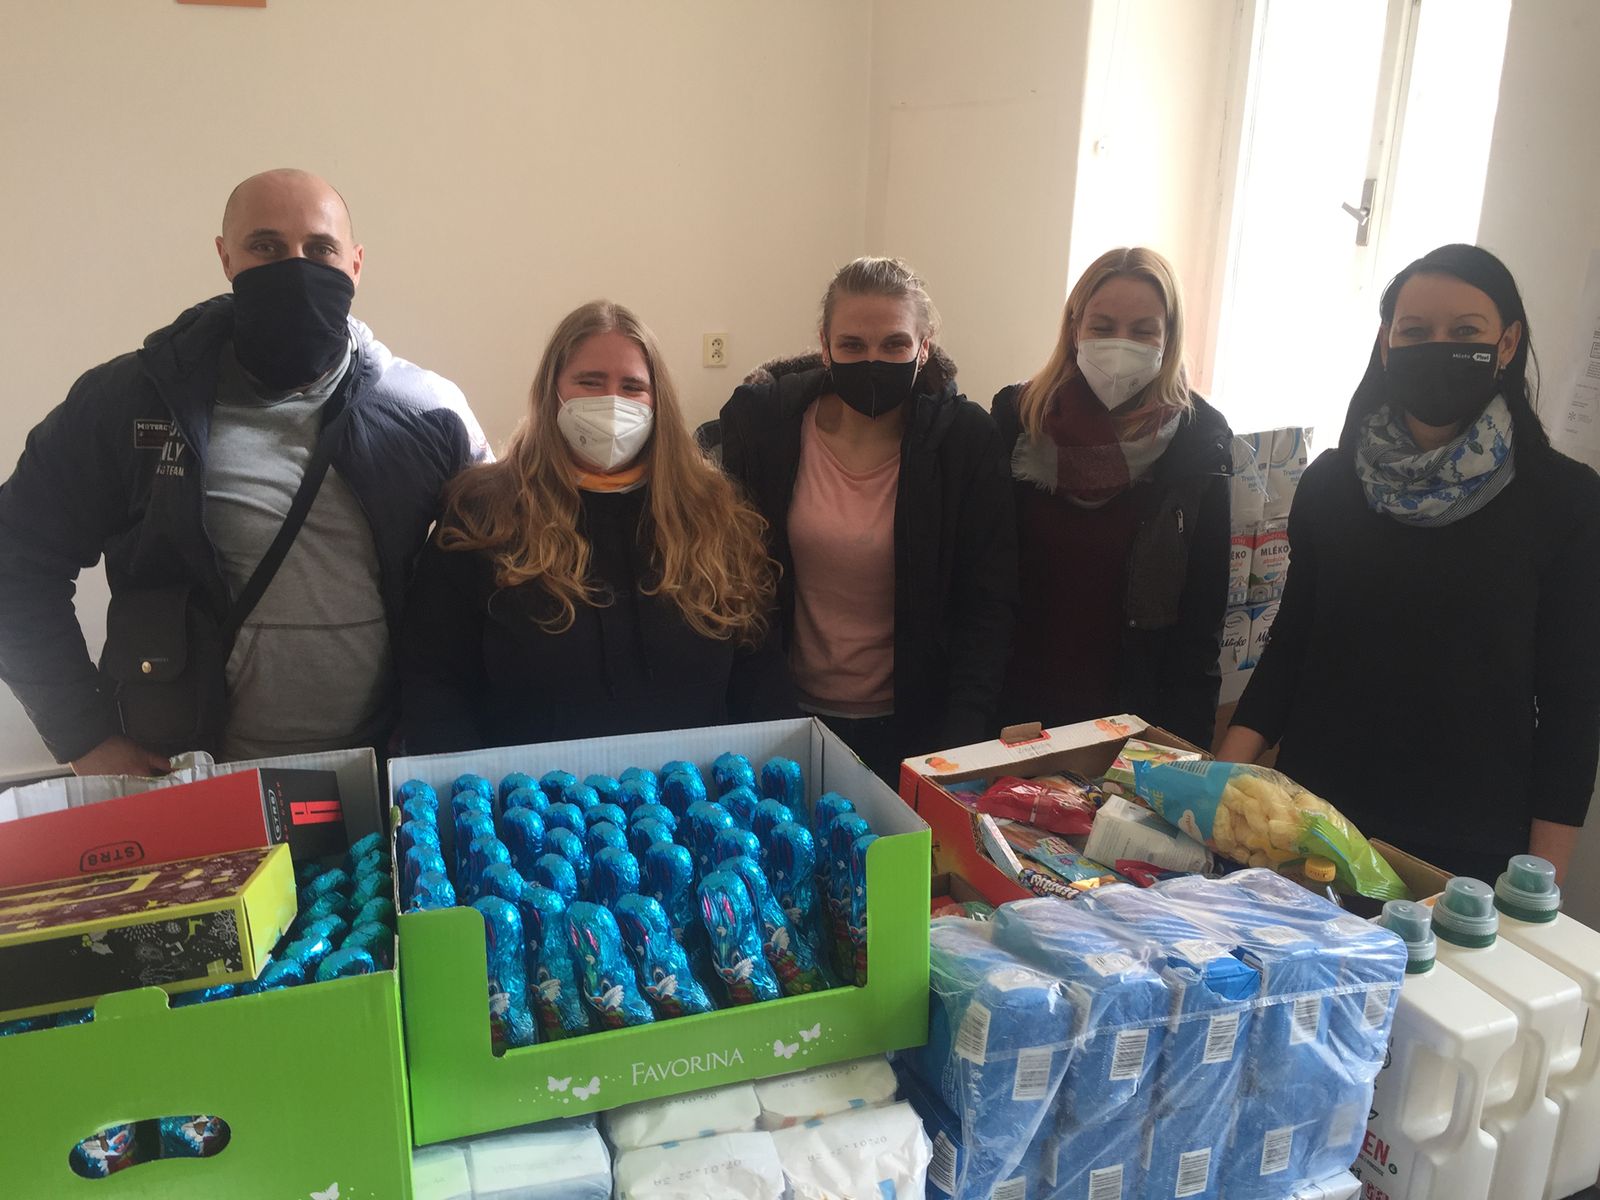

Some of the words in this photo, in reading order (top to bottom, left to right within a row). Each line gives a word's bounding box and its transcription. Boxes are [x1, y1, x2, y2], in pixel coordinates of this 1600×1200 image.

[1231, 550, 1247, 560] ÉKO
[1260, 545, 1289, 557] MLÉKO
[88, 846, 135, 866] STR8
[631, 1047, 744, 1086] FAVORINA
[1363, 1129, 1390, 1166] EN
